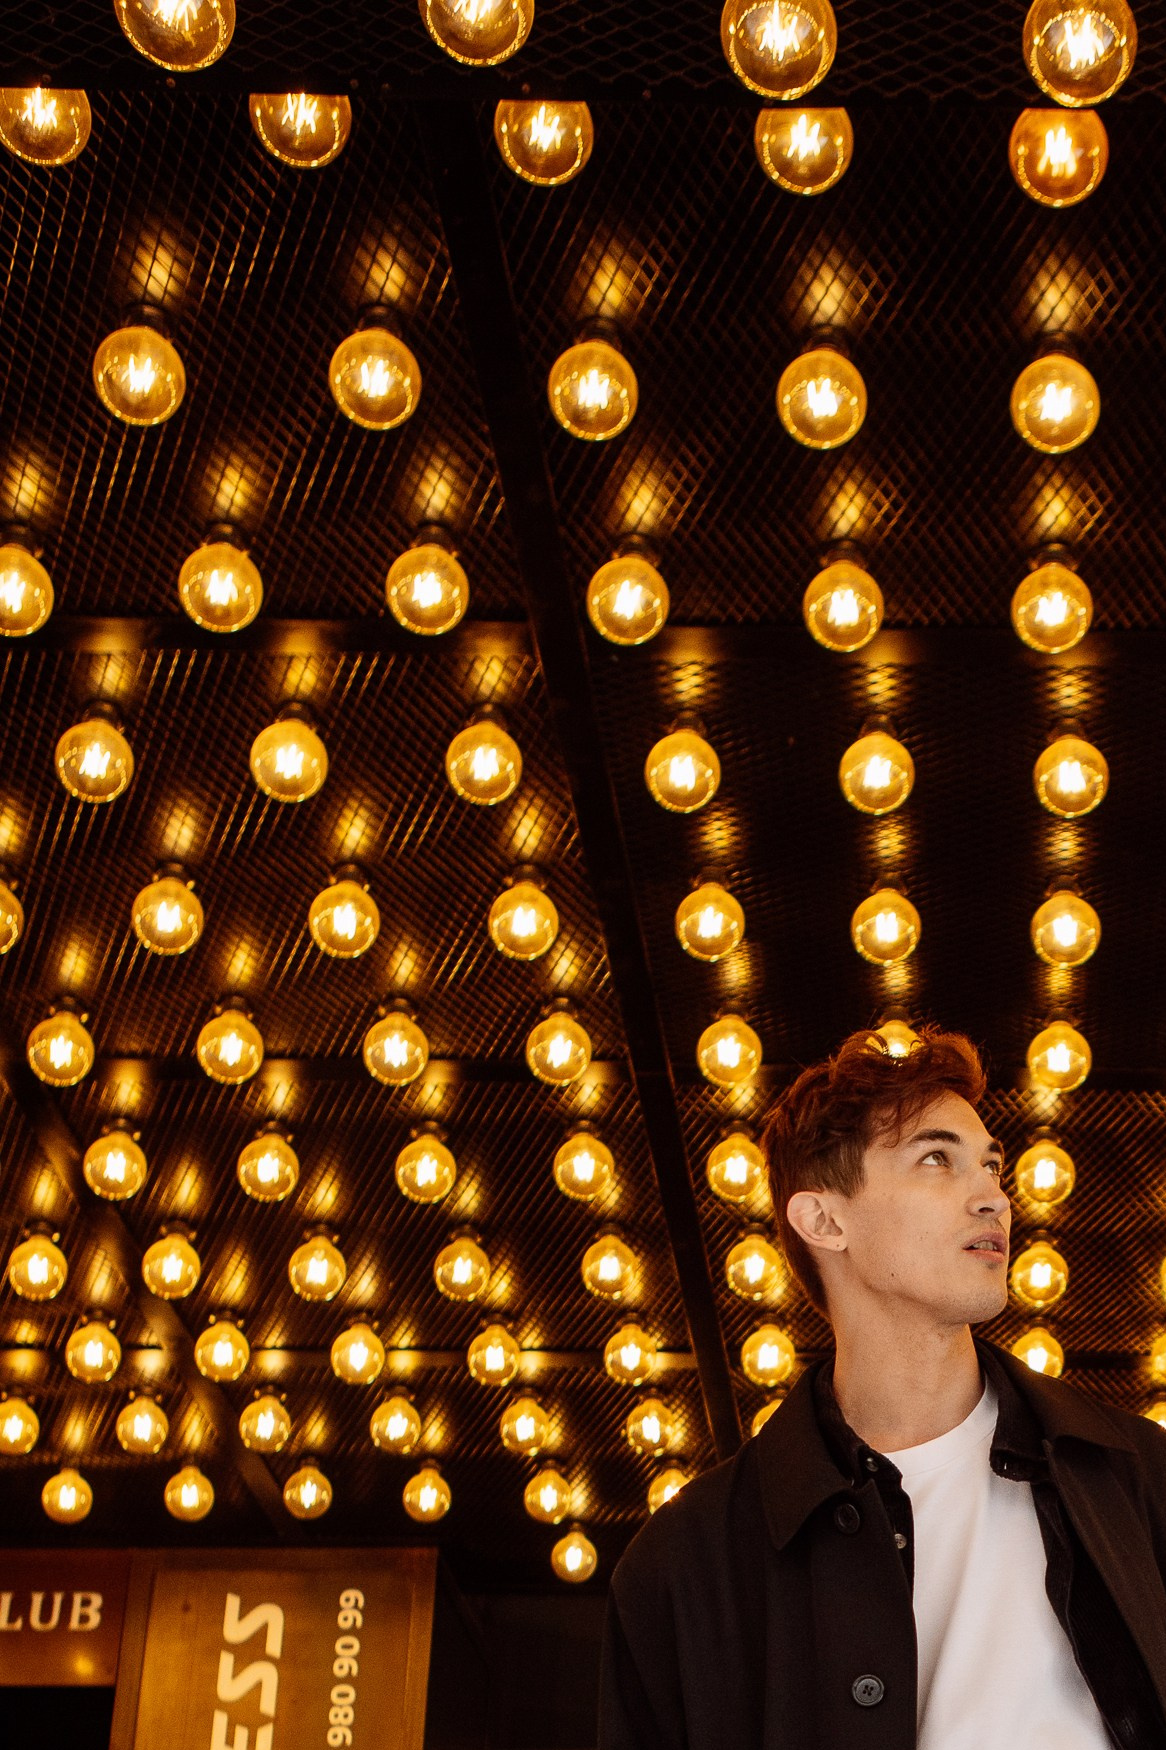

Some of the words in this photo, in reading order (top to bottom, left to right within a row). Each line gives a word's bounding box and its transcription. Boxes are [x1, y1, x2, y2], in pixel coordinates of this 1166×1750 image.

[337, 1588, 365, 1630] 99
[333, 1635, 360, 1677] 90
[327, 1684, 356, 1747] 980
